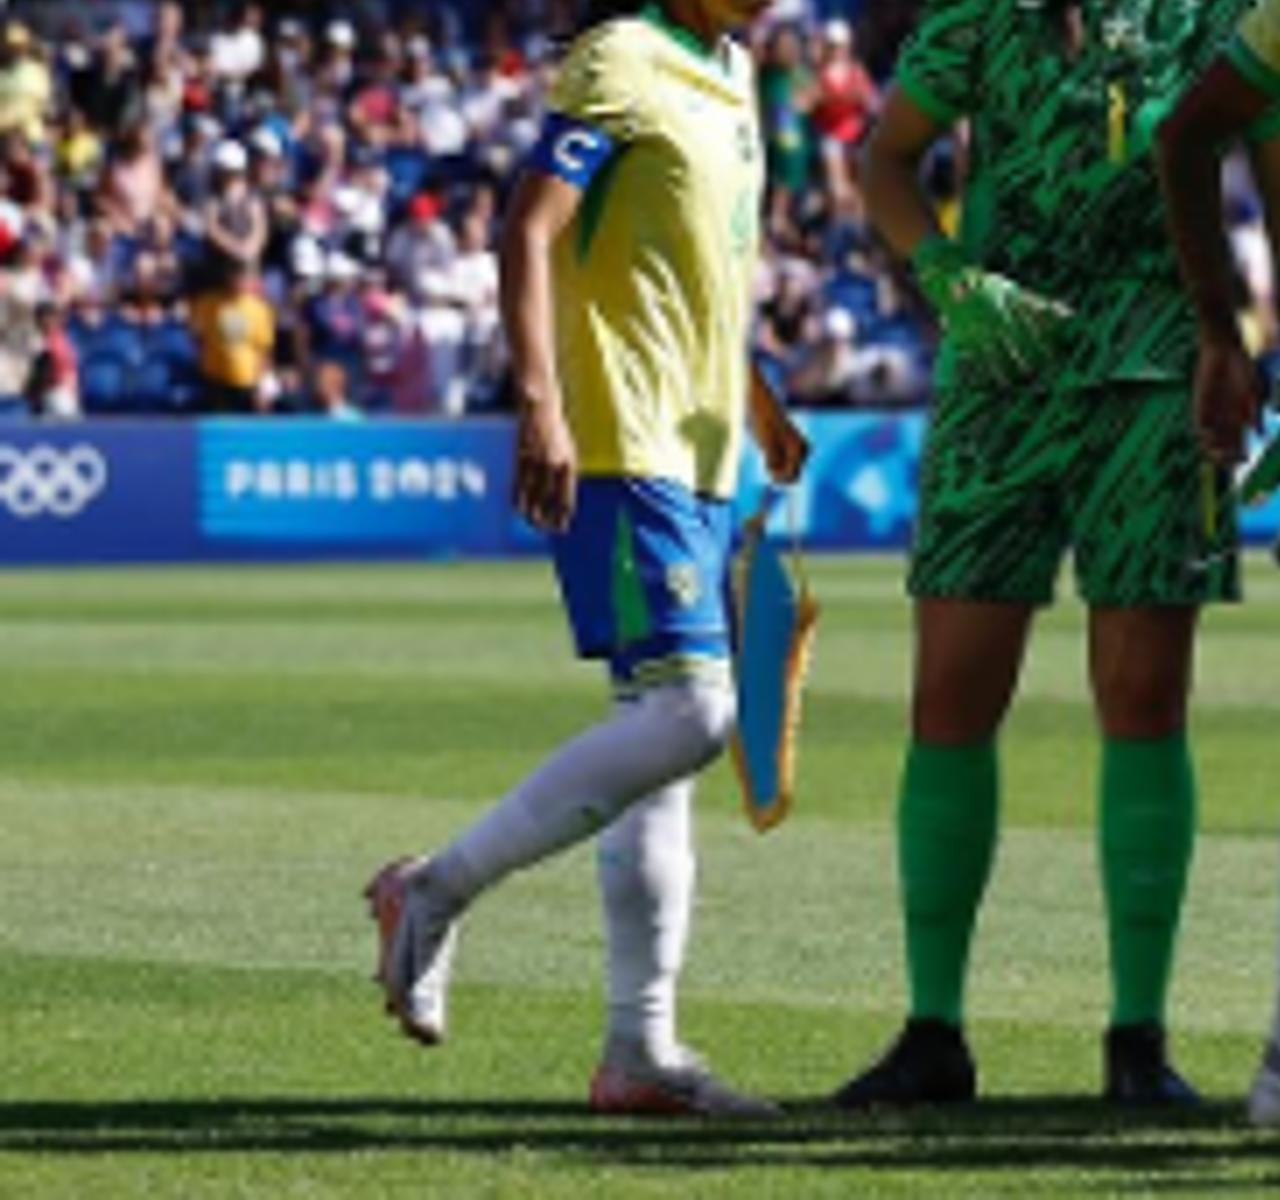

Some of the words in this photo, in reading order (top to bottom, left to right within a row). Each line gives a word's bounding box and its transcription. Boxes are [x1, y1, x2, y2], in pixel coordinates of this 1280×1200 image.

[553, 128, 599, 172] C
[225, 457, 358, 501] PARIS
[369, 457, 487, 501] 2024
